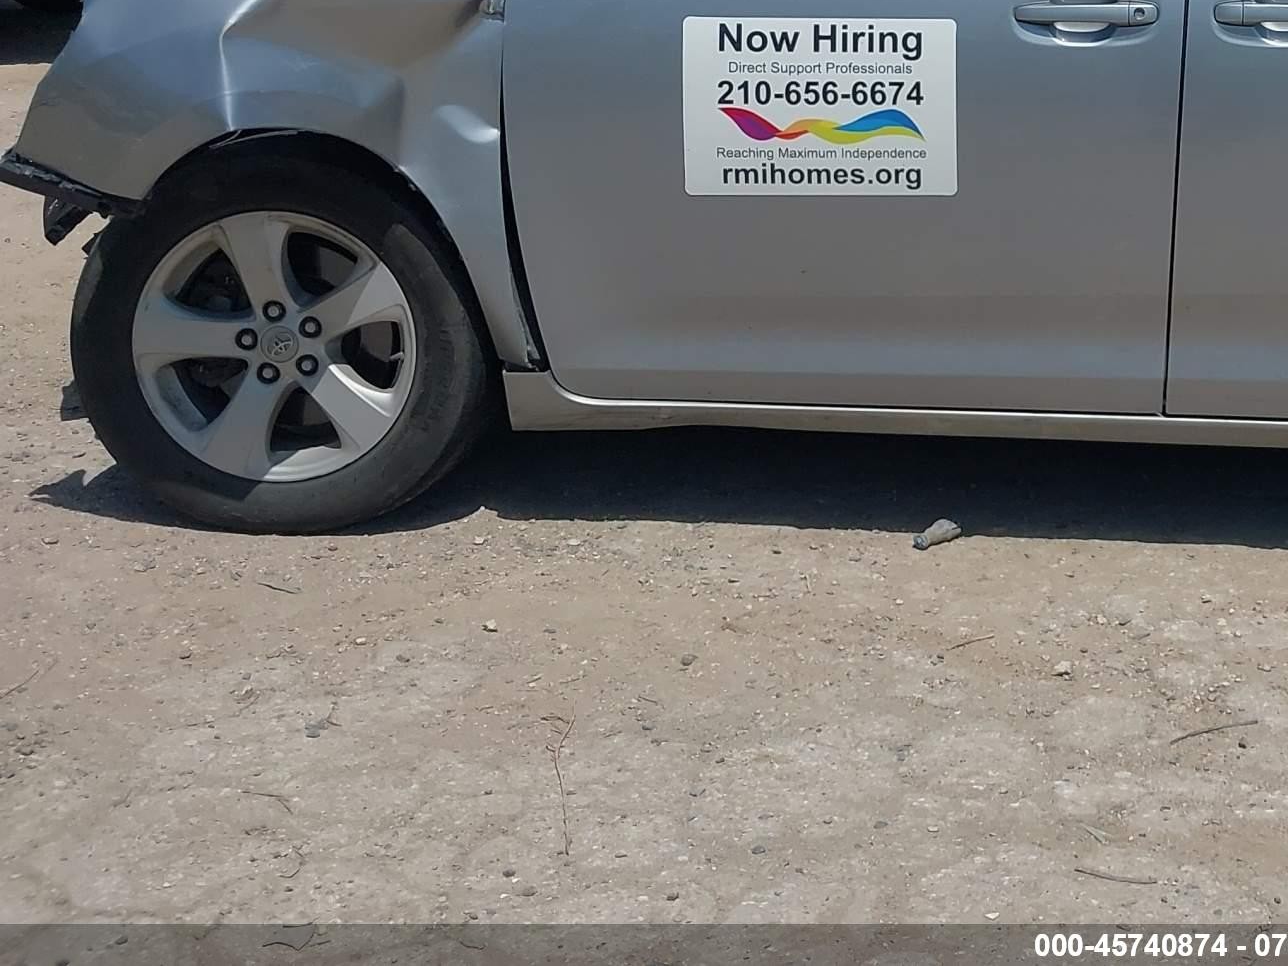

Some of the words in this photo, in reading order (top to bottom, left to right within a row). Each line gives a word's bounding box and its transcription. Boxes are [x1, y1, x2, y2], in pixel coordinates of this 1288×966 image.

[718, 23, 800, 53] Now
[813, 23, 923, 61] Hiring
[728, 61, 767, 74] Direct
[770, 61, 822, 76] Support
[825, 61, 913, 75] Professionals
[717, 80, 924, 106] 210-656-6674
[716, 146, 774, 161] Reaching
[778, 147, 838, 159] Maximum
[841, 147, 927, 161] Independence
[722, 162, 922, 190] rmihomes.org
